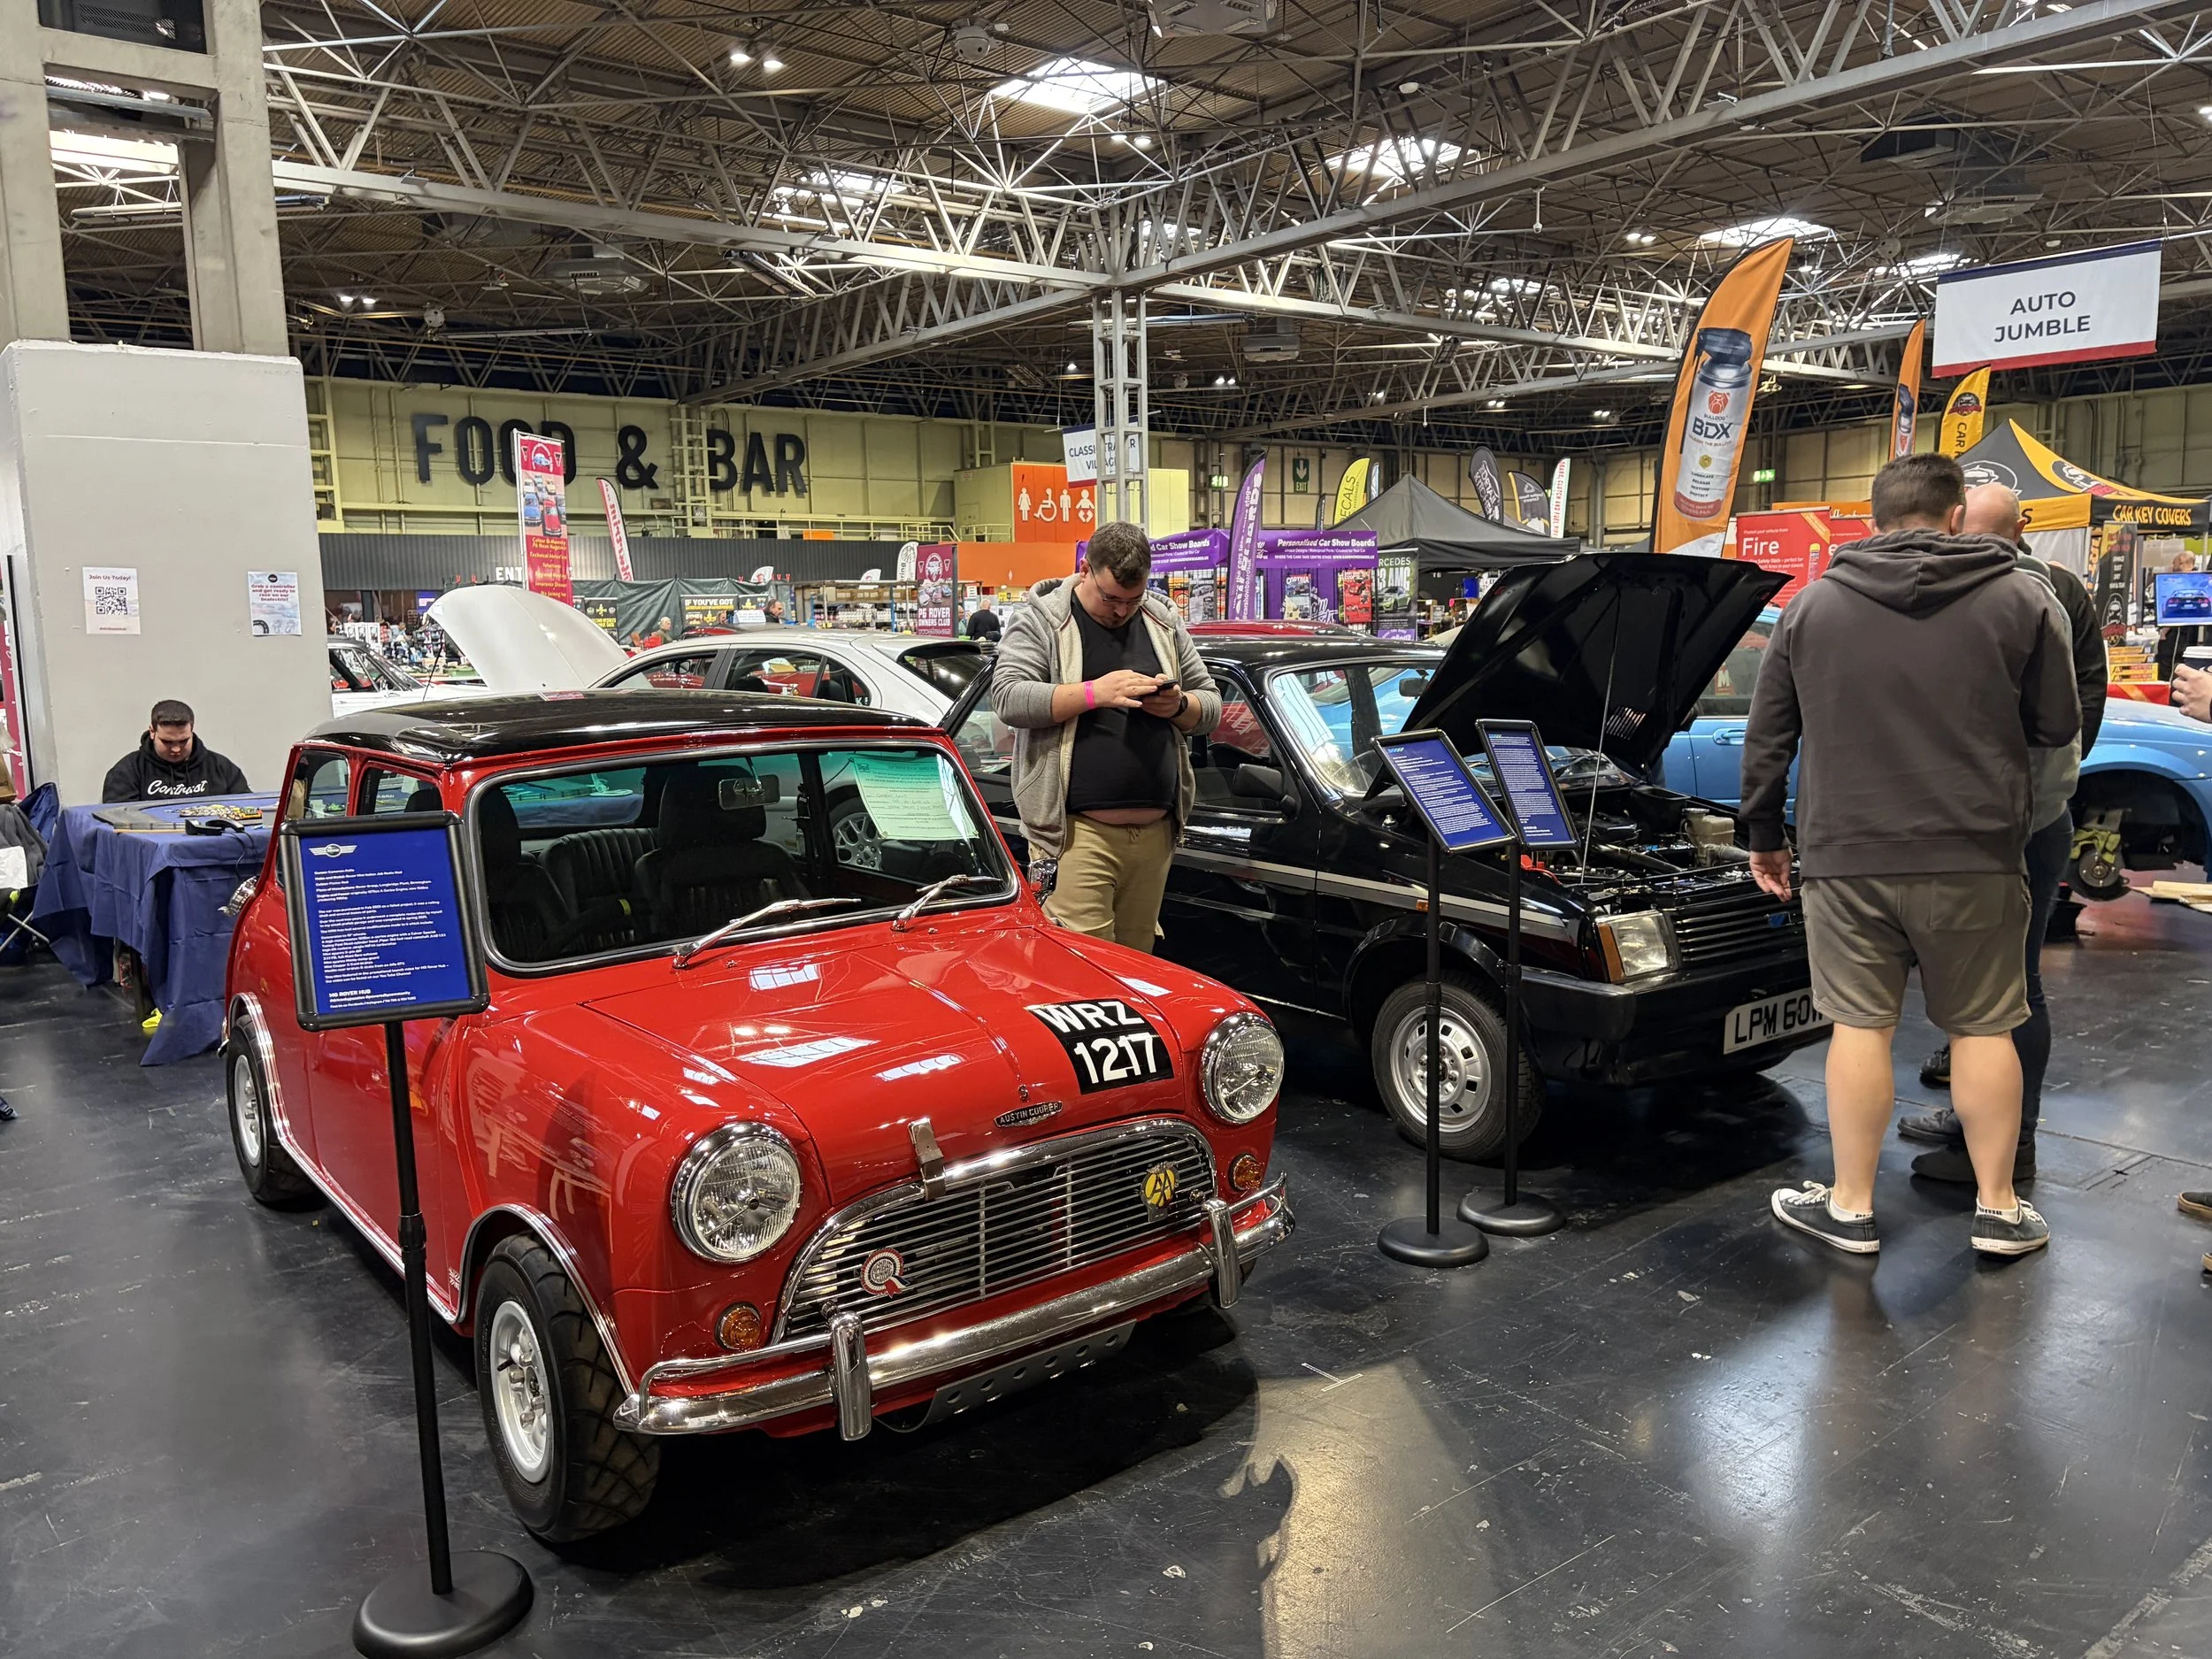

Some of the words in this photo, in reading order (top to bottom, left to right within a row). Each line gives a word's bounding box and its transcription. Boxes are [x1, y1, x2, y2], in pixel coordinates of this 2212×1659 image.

[2010, 291, 2077, 315] AUTO
[1994, 315, 2091, 342] JUMBLE
[1692, 416, 1732, 439] BDX
[1955, 422, 1967, 448] CAR
[618, 425, 659, 489] &
[708, 428, 809, 493] BAR
[1069, 445, 1096, 457] CLASSI
[1296, 483, 1308, 492] EXIT
[1474, 472, 1494, 520] KITCHEN
[1481, 468, 1496, 503] DETAIL
[2113, 504, 2133, 522] CAR
[2135, 506, 2154, 524] KEY
[2155, 508, 2192, 526] COVERS
[1169, 541, 1187, 550] Show
[1189, 539, 1210, 549] Boards
[1742, 537, 1779, 556] Fire
[1379, 557, 1410, 566] RCEDES
[1388, 567, 1410, 591] AMG
[918, 607, 927, 618] P6
[929, 607, 950, 618] ROVER
[938, 618, 950, 626] CLUB
[147, 780, 208, 796] Contrast
[1034, 1001, 1145, 1033] WRZ
[1735, 1002, 1778, 1044] LPM
[1073, 1032, 1157, 1085] 1217
[1000, 1110, 1027, 1125] AUSTIN
[1028, 1102, 1059, 1117] COOPER
